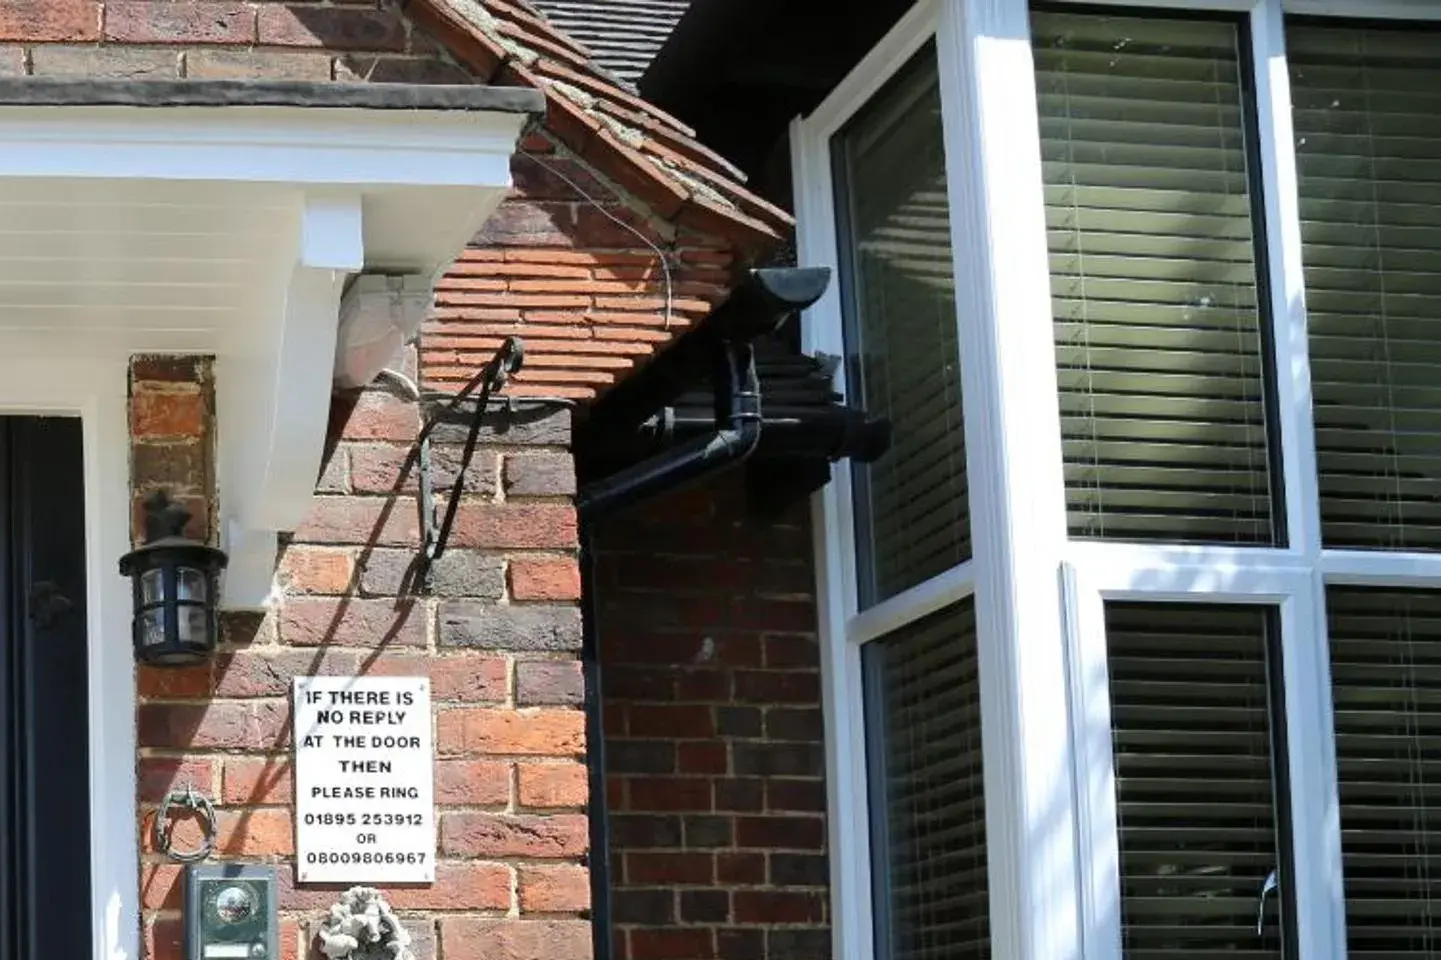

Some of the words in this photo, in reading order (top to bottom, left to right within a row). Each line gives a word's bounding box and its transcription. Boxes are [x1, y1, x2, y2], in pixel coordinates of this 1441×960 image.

[306, 691, 322, 704] IF
[328, 691, 389, 705] THERE
[397, 692, 413, 705] IS
[317, 710, 343, 724] NO
[350, 711, 405, 724] REPLY
[304, 735, 323, 747] AT
[333, 736, 365, 748] THE
[372, 736, 420, 748] DOOR
[339, 761, 391, 773] THEN
[312, 787, 374, 798] PLEASE
[380, 787, 418, 799] RING
[305, 813, 356, 825] 01895
[362, 814, 422, 825] 253912
[357, 834, 375, 844] OR
[307, 852, 425, 864] 08009806967
